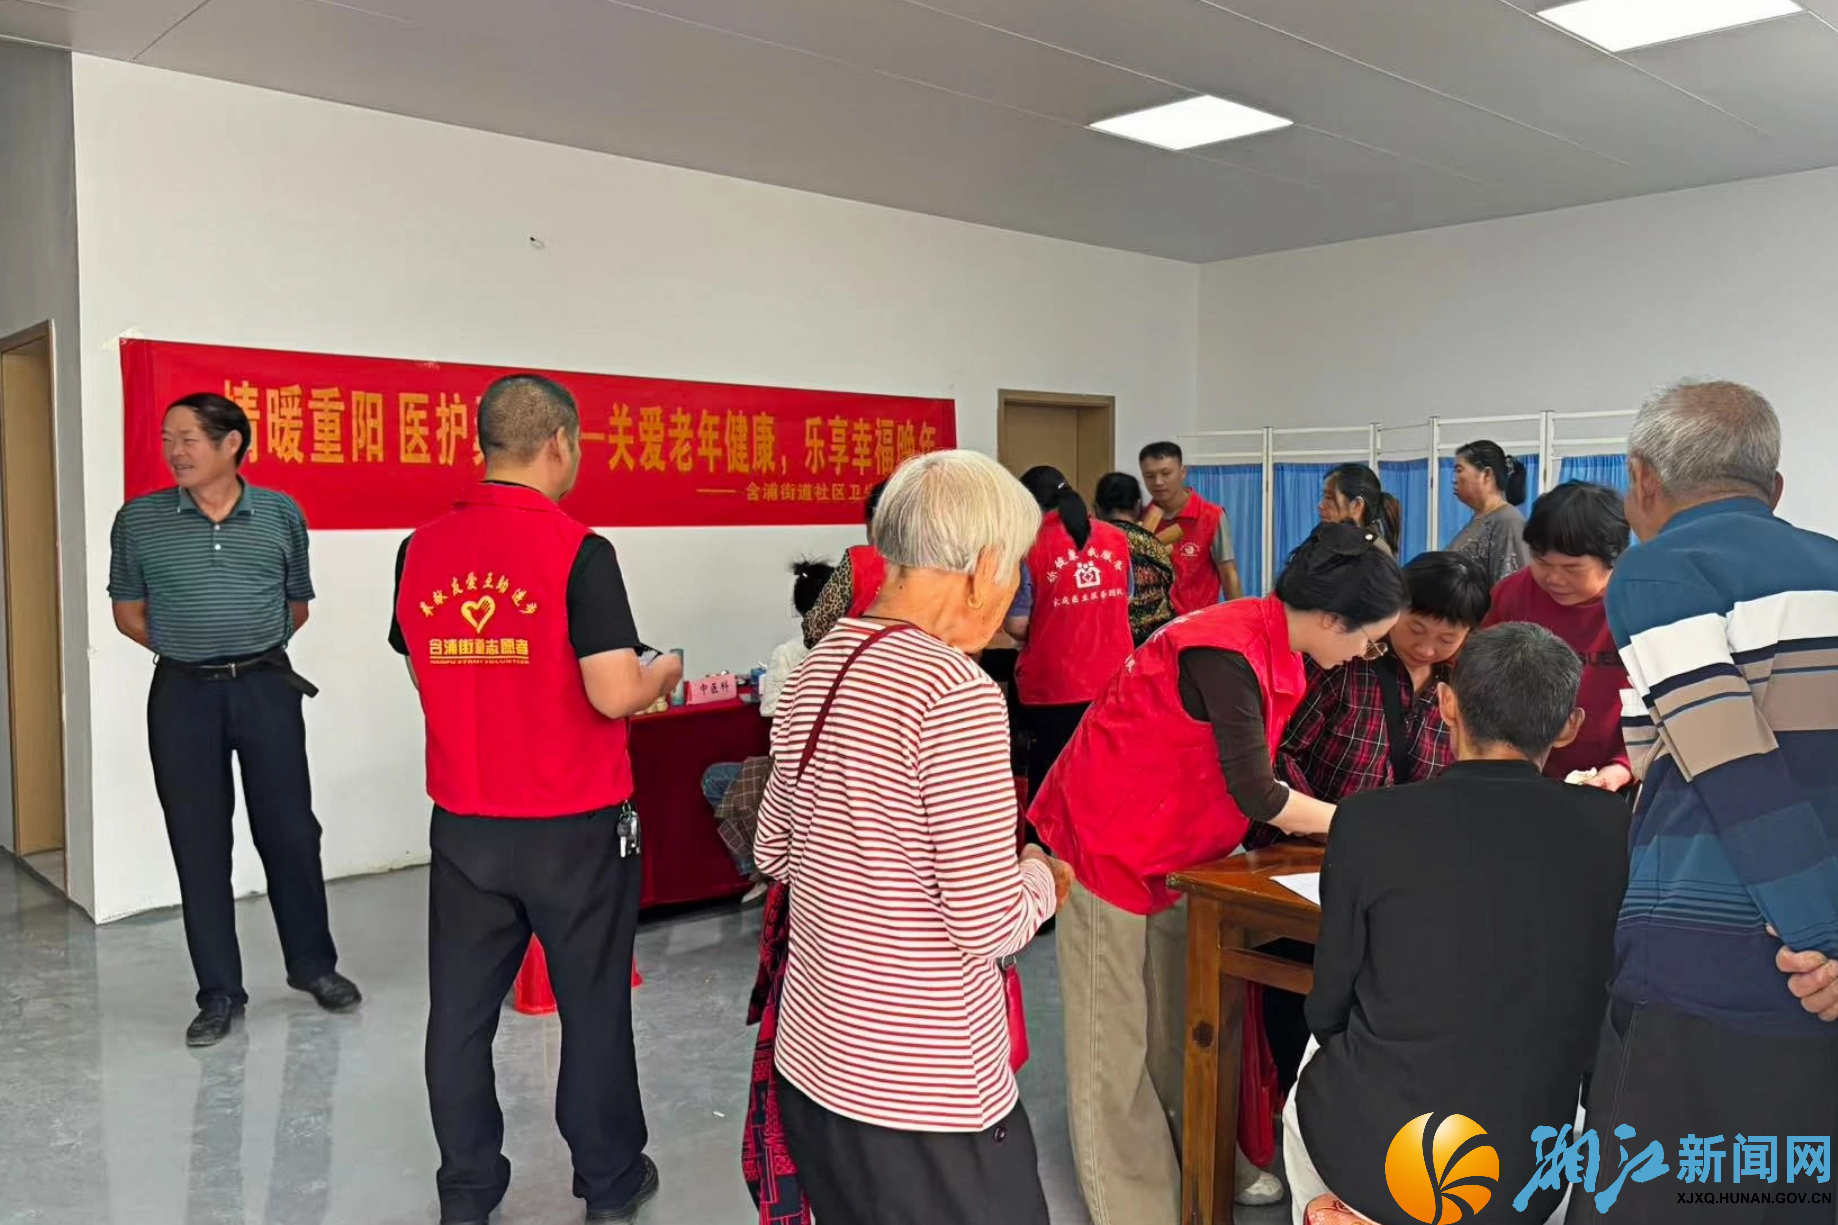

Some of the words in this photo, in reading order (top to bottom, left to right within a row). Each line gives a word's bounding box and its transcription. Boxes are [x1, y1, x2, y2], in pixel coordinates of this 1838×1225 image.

[224, 380, 384, 464] 情暖重阳
[399, 392, 486, 466] 医护
[699, 681, 730, 696] 中医科
